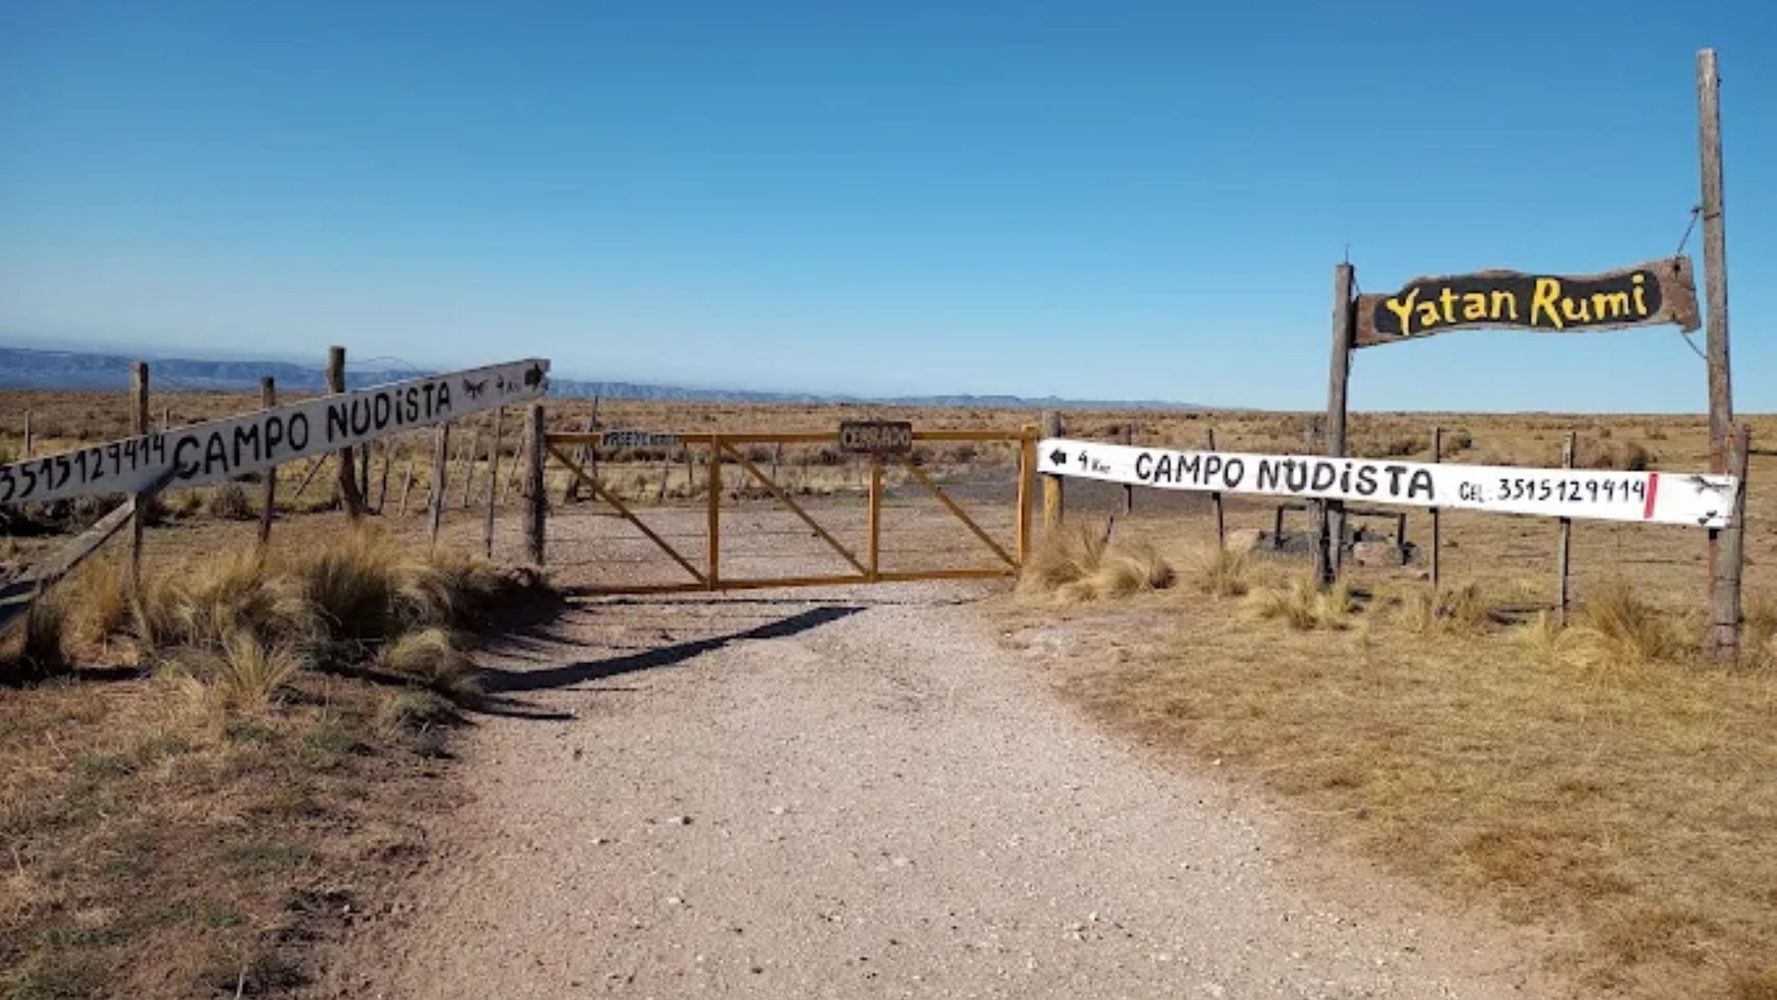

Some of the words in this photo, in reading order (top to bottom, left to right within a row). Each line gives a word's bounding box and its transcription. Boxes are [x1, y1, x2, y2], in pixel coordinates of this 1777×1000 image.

[1386, 287, 1519, 336] Yatan
[1530, 274, 1648, 329] Rumi
[174, 409, 309, 480] CAMPO
[842, 427, 911, 448] CERRADO
[1135, 453, 1244, 488] CAMPO
